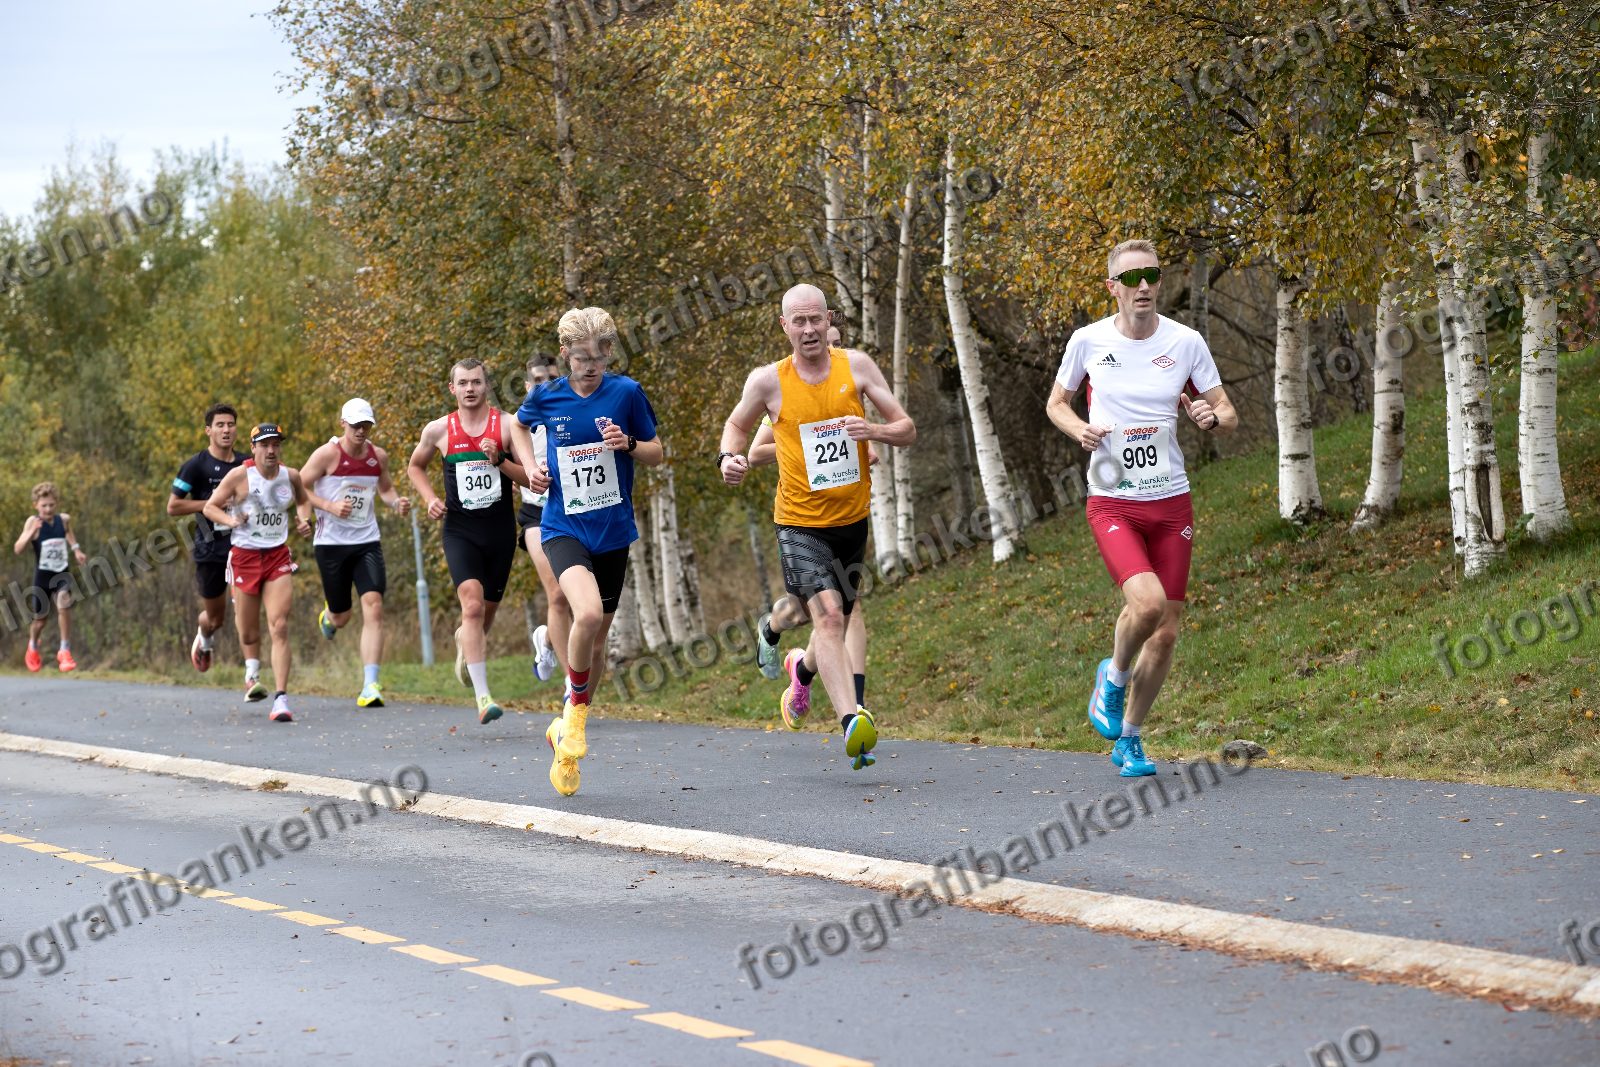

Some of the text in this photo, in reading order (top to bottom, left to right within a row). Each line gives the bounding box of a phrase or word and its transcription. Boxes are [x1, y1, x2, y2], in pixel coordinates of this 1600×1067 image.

[813, 421, 846, 433] NORGES
[1123, 426, 1159, 436] NORGES
[817, 428, 842, 439] LØPET
[1126, 433, 1153, 443] LØPET
[567, 446, 603, 458] NORGES
[815, 440, 849, 464] 224
[1123, 445, 1157, 470] 909
[572, 454, 598, 464] LØPET
[465, 474, 492, 491] 340
[571, 465, 606, 488] 173
[1138, 475, 1170, 486] Aurskog
[587, 490, 618, 504] Aurskog
[256, 513, 283, 526] 1006
